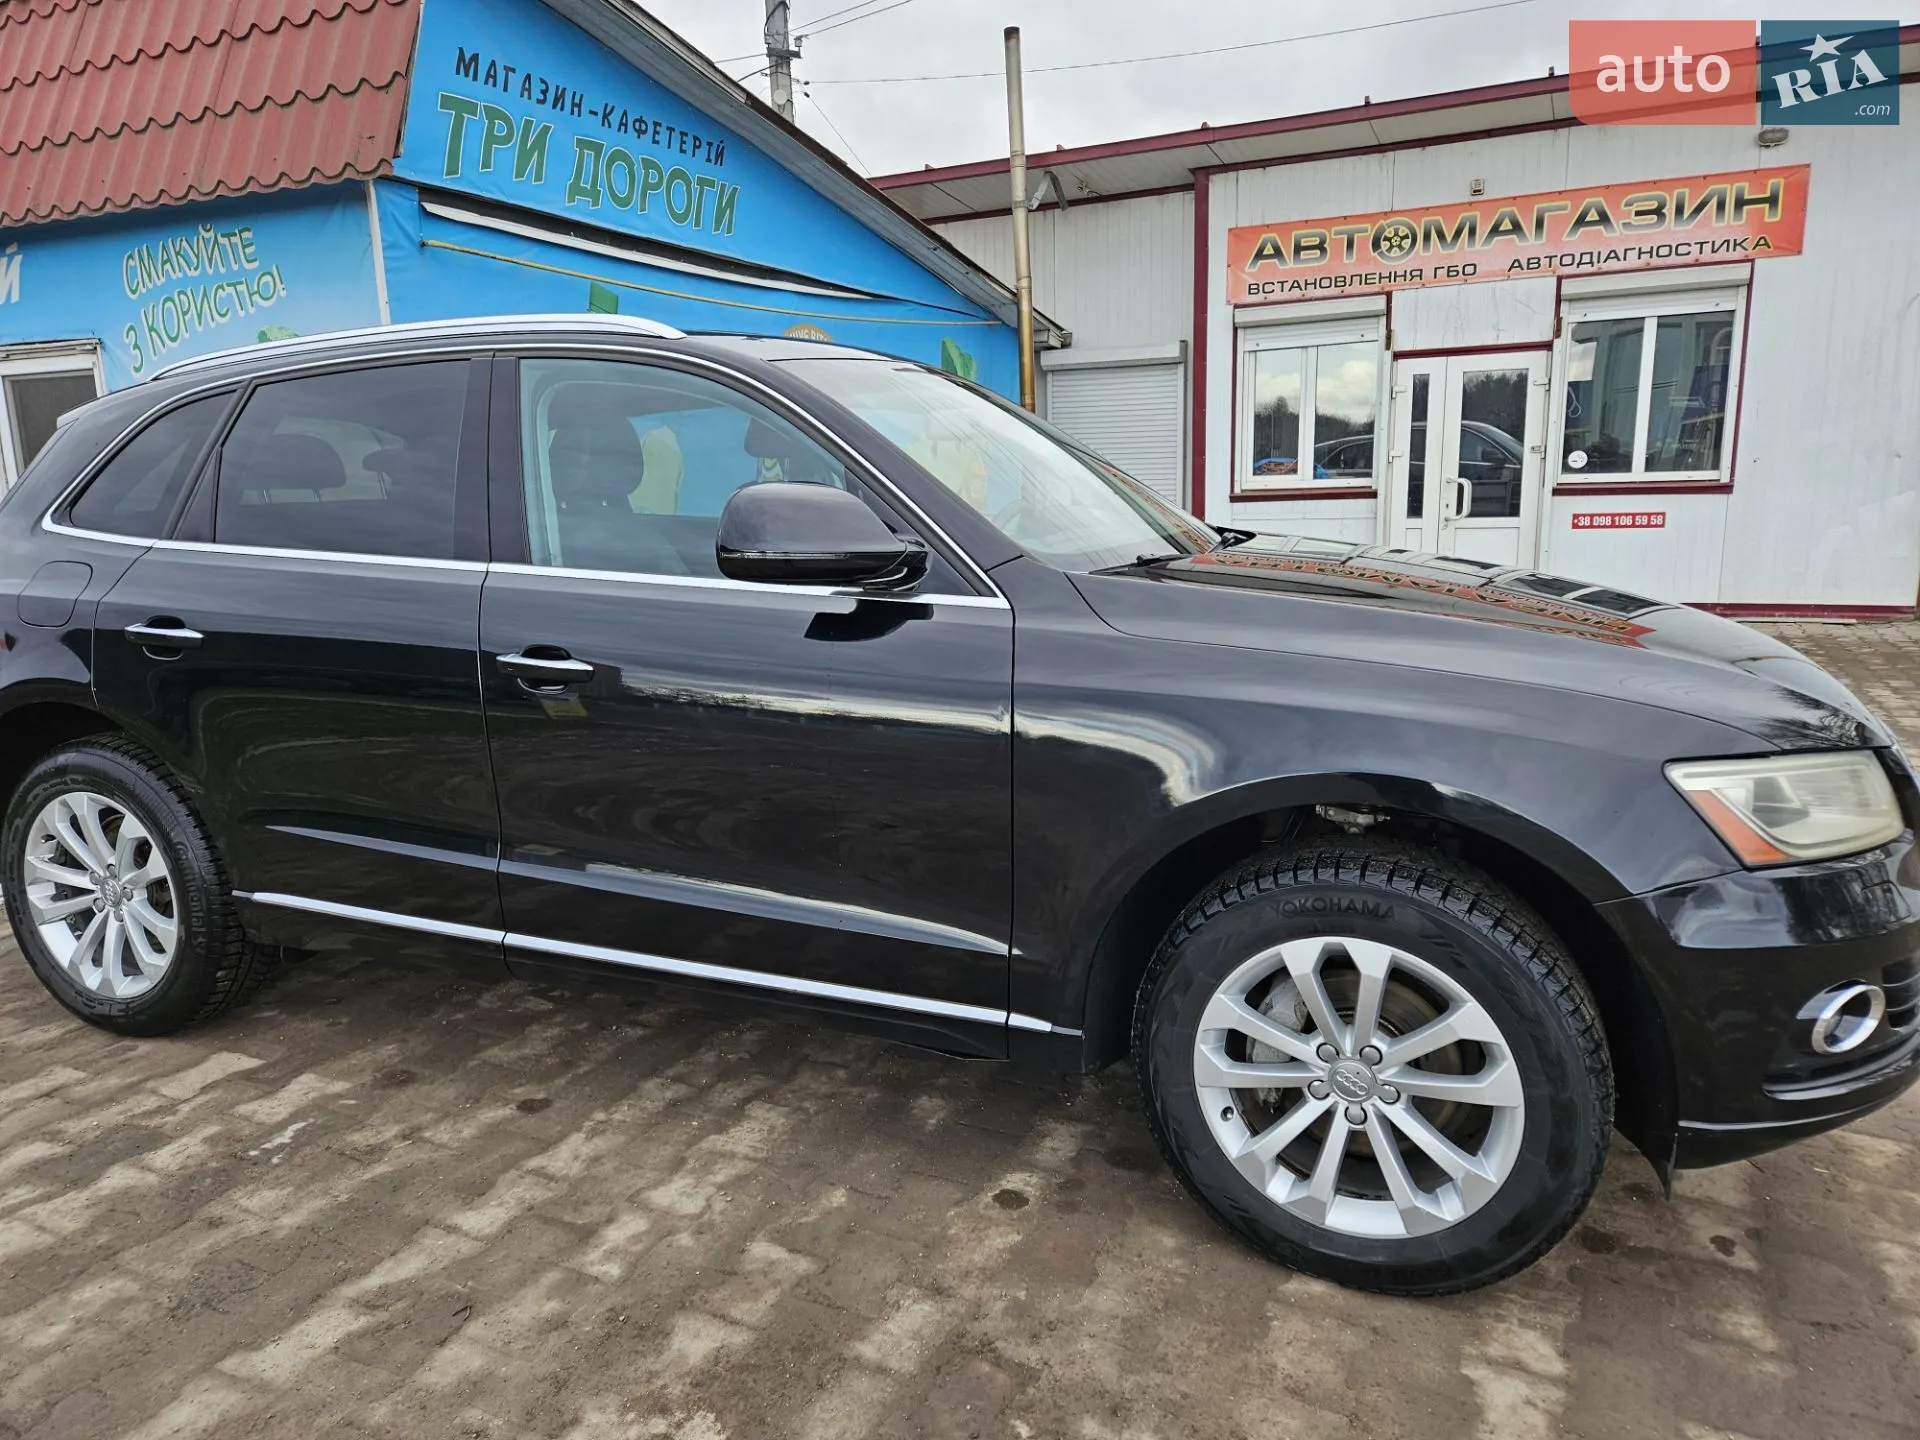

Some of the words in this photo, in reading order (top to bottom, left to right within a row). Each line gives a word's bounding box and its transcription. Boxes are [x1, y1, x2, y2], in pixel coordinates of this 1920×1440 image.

[455, 46, 726, 167] МАГАЗИН-КАФЕТЕРІЙ
[438, 91, 554, 186] ТРИ
[565, 135, 741, 237] ДОРОГИ
[122, 223, 259, 300] СМАКУЙТЕ
[1247, 179, 1784, 272] АВТОМАГАЗИН
[1247, 267, 1424, 296] ВСТАНОВЛЕННЯ
[1432, 261, 1478, 280] ГБО
[1507, 235, 1772, 273] АВТОДІАГНОСТИКА
[140, 263, 288, 361] КОРИСТЮ!
[1593, 516, 1611, 526] 098
[1270, 896, 1396, 921] YOKOHAMA
